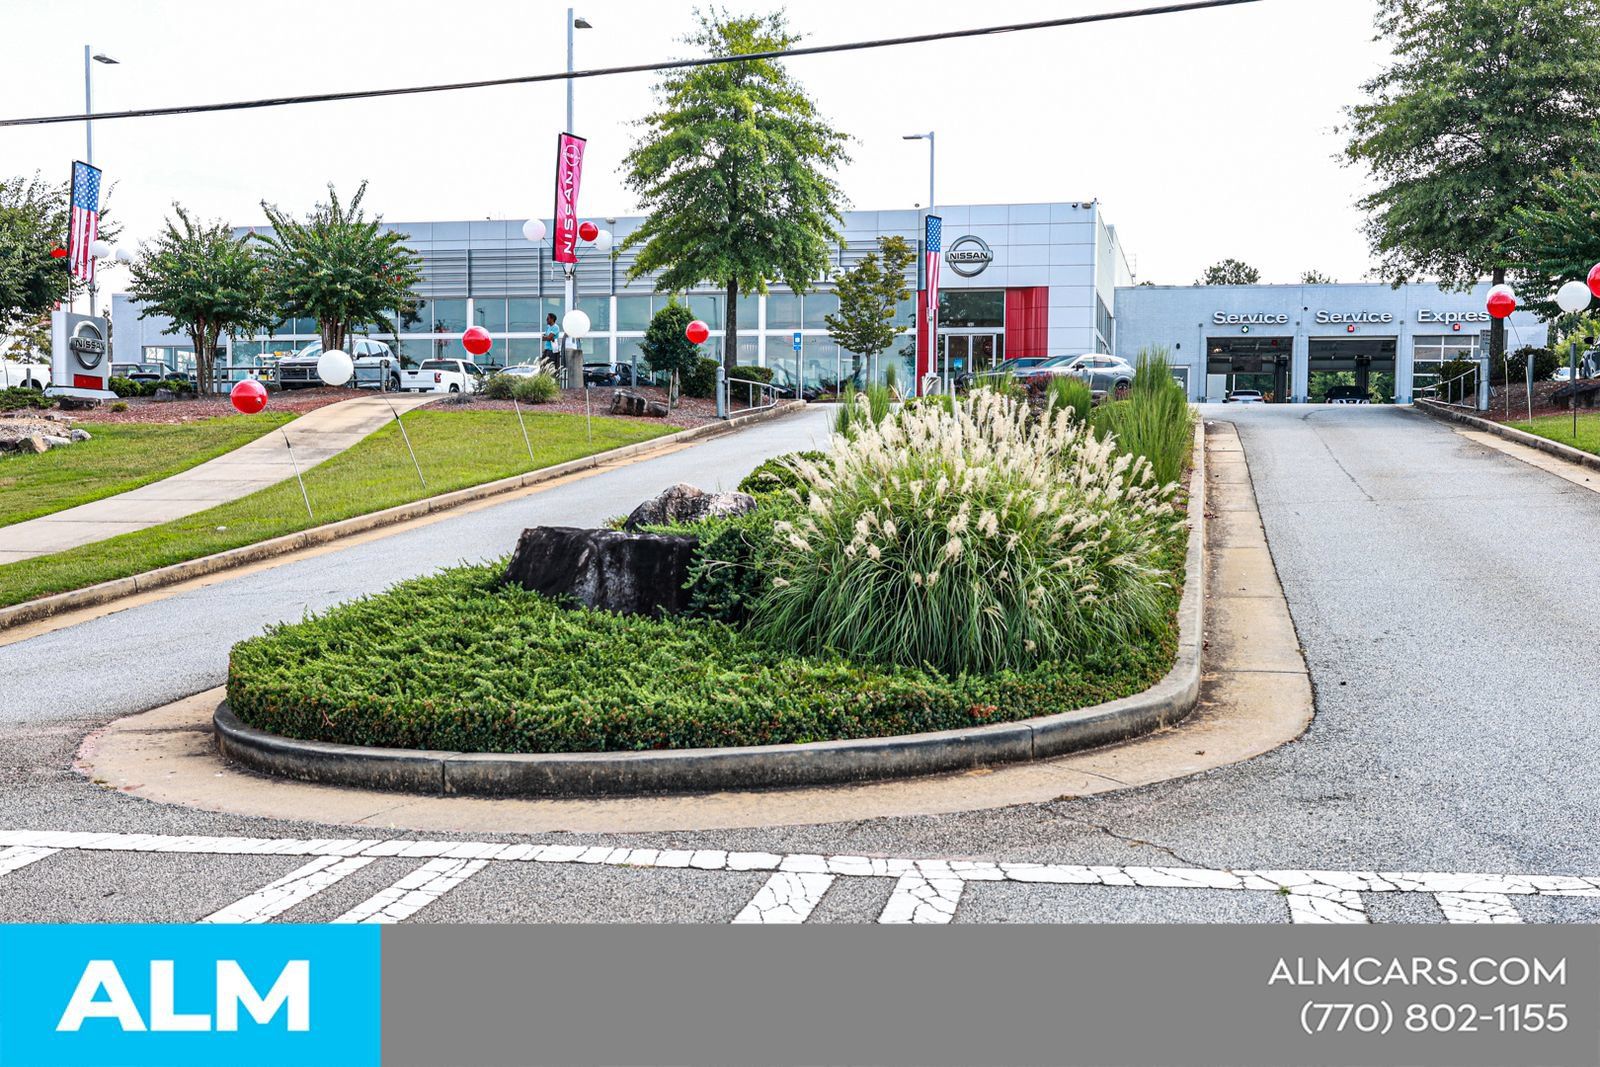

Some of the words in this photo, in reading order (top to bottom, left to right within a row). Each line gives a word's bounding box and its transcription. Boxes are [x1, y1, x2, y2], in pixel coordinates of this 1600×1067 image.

[563, 171, 573, 254] NISSAN
[949, 252, 988, 260] NISSAN
[1213, 310, 1289, 325] Service
[1316, 310, 1393, 324] Service
[1418, 309, 1491, 325] Expres
